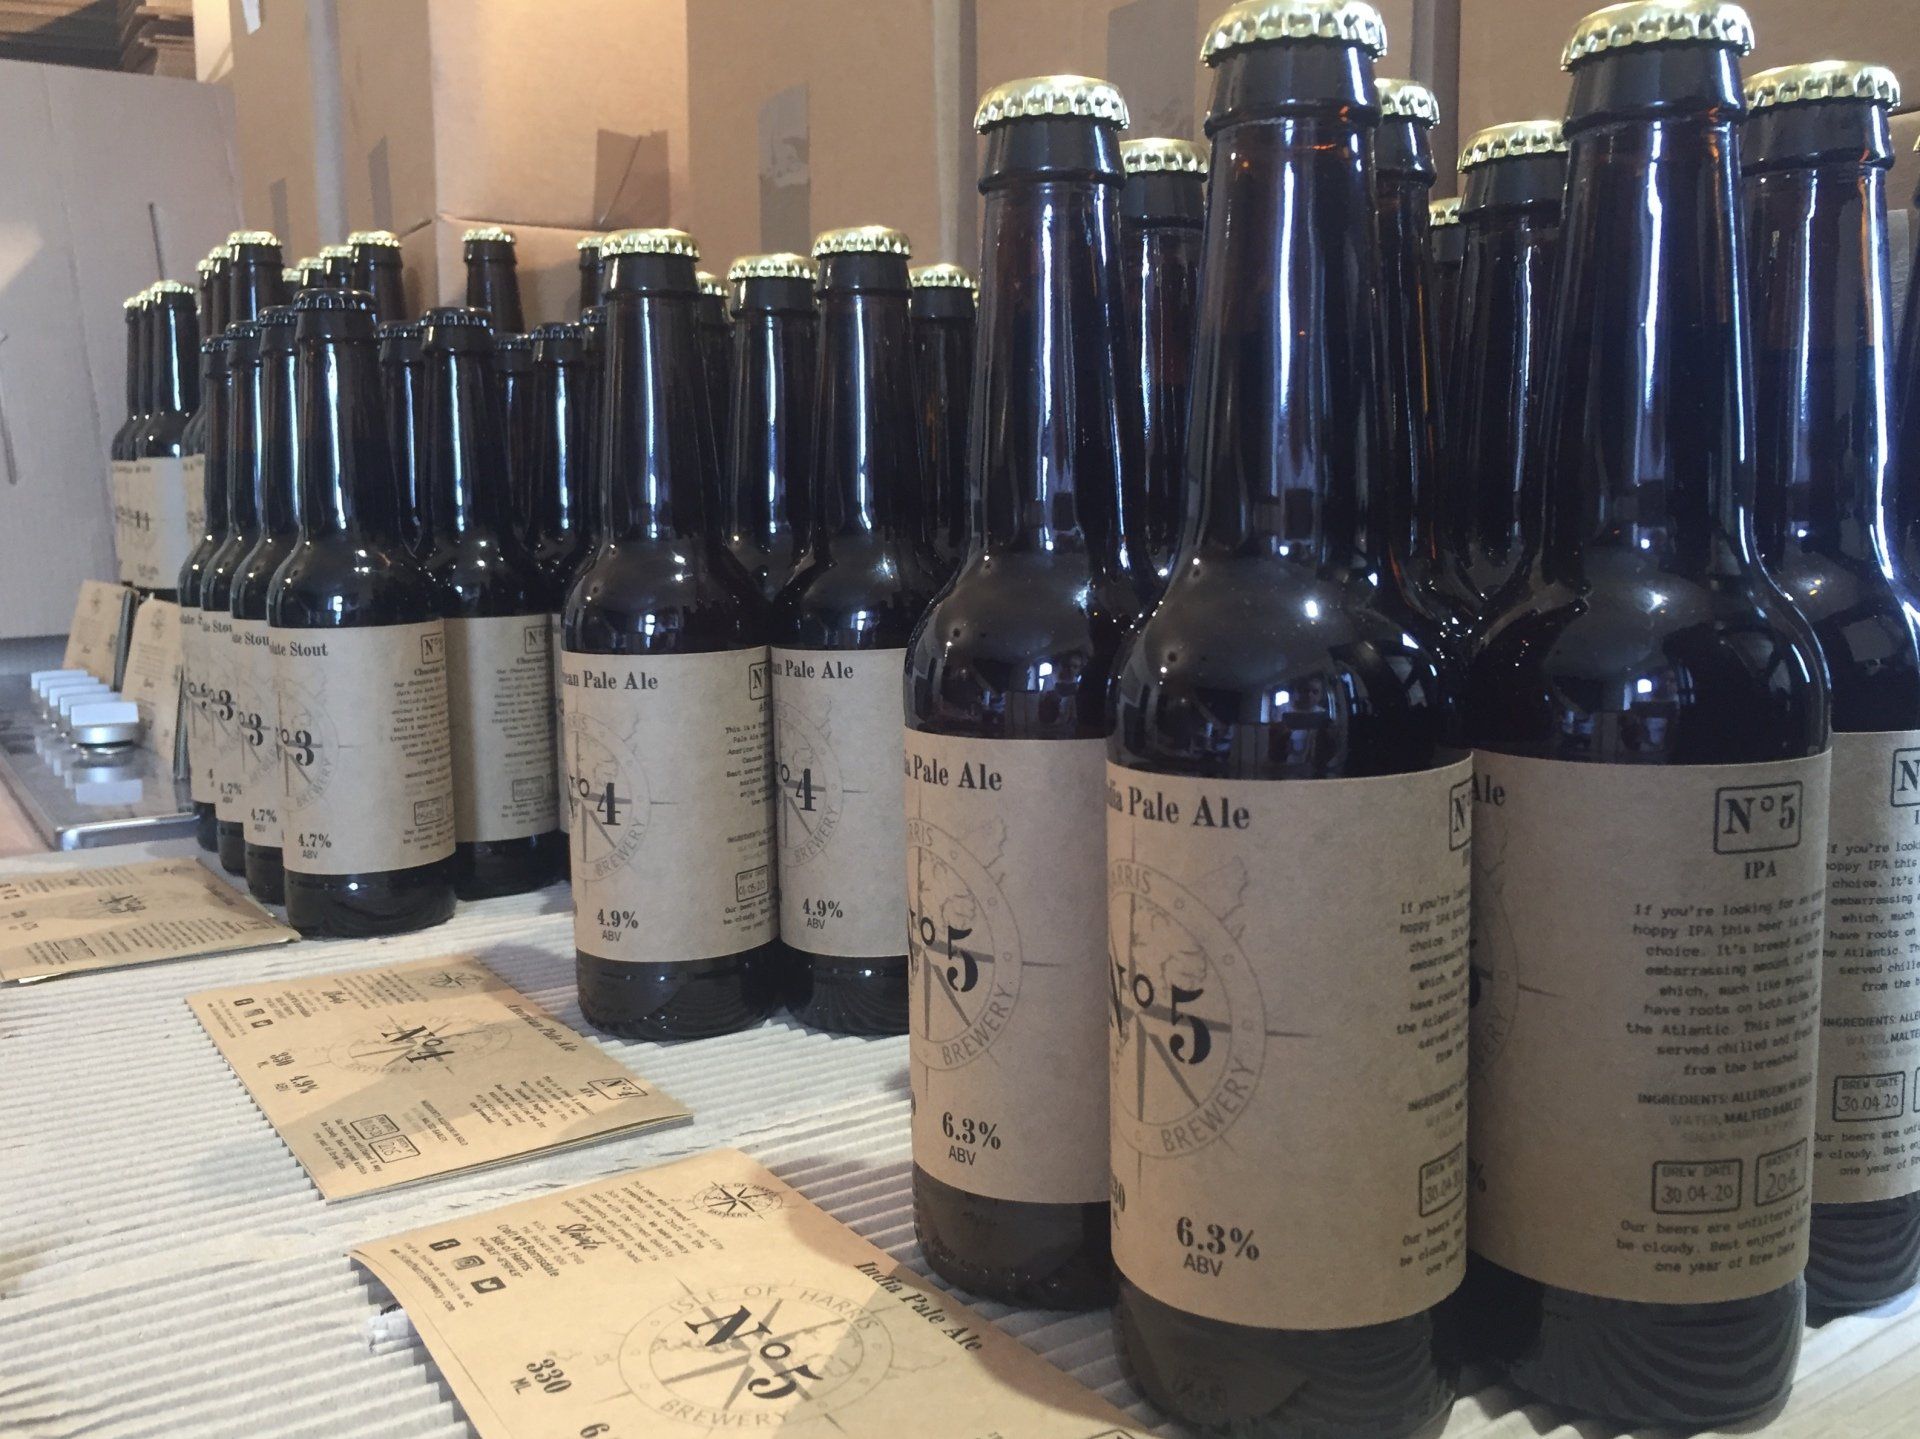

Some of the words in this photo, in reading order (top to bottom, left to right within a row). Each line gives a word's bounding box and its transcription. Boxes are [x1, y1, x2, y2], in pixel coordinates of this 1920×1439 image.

[245, 632, 269, 646] Stou
[290, 641, 328, 657] Stout
[785, 660, 814, 678] Pale
[821, 661, 854, 680] Ale
[584, 670, 618, 690] Pale
[625, 672, 658, 690] Ale
[913, 754, 948, 787] Pale
[957, 761, 1003, 792] Ale
[1129, 785, 1180, 825] Pale
[1193, 796, 1251, 830] Ale
[298, 833, 332, 848] 4.7%
[1845, 842, 1889, 856] you're
[1744, 860, 1777, 881] IPA
[1894, 858, 1917, 869] this
[802, 898, 843, 919] 4.9%
[1634, 904, 1653, 916] If
[1661, 904, 1714, 919] you're
[1723, 903, 1773, 917] looking
[1890, 911, 1914, 921] much
[597, 908, 640, 929] 4.9%
[807, 917, 825, 930] ABV
[601, 930, 621, 942] ABV
[1633, 923, 1678, 939] hoppy
[1688, 924, 1714, 937] IPA
[1721, 925, 1751, 937] this
[1830, 931, 1860, 941] have
[1866, 928, 1899, 940] roots
[1904, 927, 1916, 936] on
[1862, 981, 1888, 992] from
[1894, 978, 1911, 989] the
[1643, 1004, 1680, 1016] have
[941, 984, 1013, 1067] BREWERY
[1626, 1022, 1653, 1035] the
[1657, 1043, 1710, 1055] served
[1684, 1065, 1716, 1076] from
[1160, 1058, 1255, 1153] BREWERY
[942, 1112, 1002, 1151] 6.3%
[1841, 1131, 1875, 1141] beers
[1881, 1129, 1899, 1140] are
[948, 1145, 977, 1167] ABV
[1839, 1166, 1860, 1176] one
[1866, 1164, 1891, 1176] year
[1620, 1220, 1647, 1232] Our
[1657, 1222, 1699, 1234] beers
[1707, 1222, 1730, 1233] are
[1176, 1216, 1260, 1261] 6.3%
[1616, 1239, 1634, 1250] be
[490, 1235, 507, 1246] Isle
[509, 1251, 533, 1271] Harris
[1183, 1253, 1224, 1277] ABV
[1655, 1261, 1681, 1272] one
[1690, 1261, 1722, 1275] year
[670, 1287, 720, 1314] ISLE
[744, 1284, 779, 1298] OF
[799, 1288, 881, 1330] HARRIS
[853, 1260, 902, 1295] India
[899, 1291, 946, 1326] Pale
[942, 1319, 982, 1353] Ale
[524, 1357, 574, 1394] 330
[509, 1377, 535, 1394] ML
[658, 1399, 791, 1428] BREWERY
